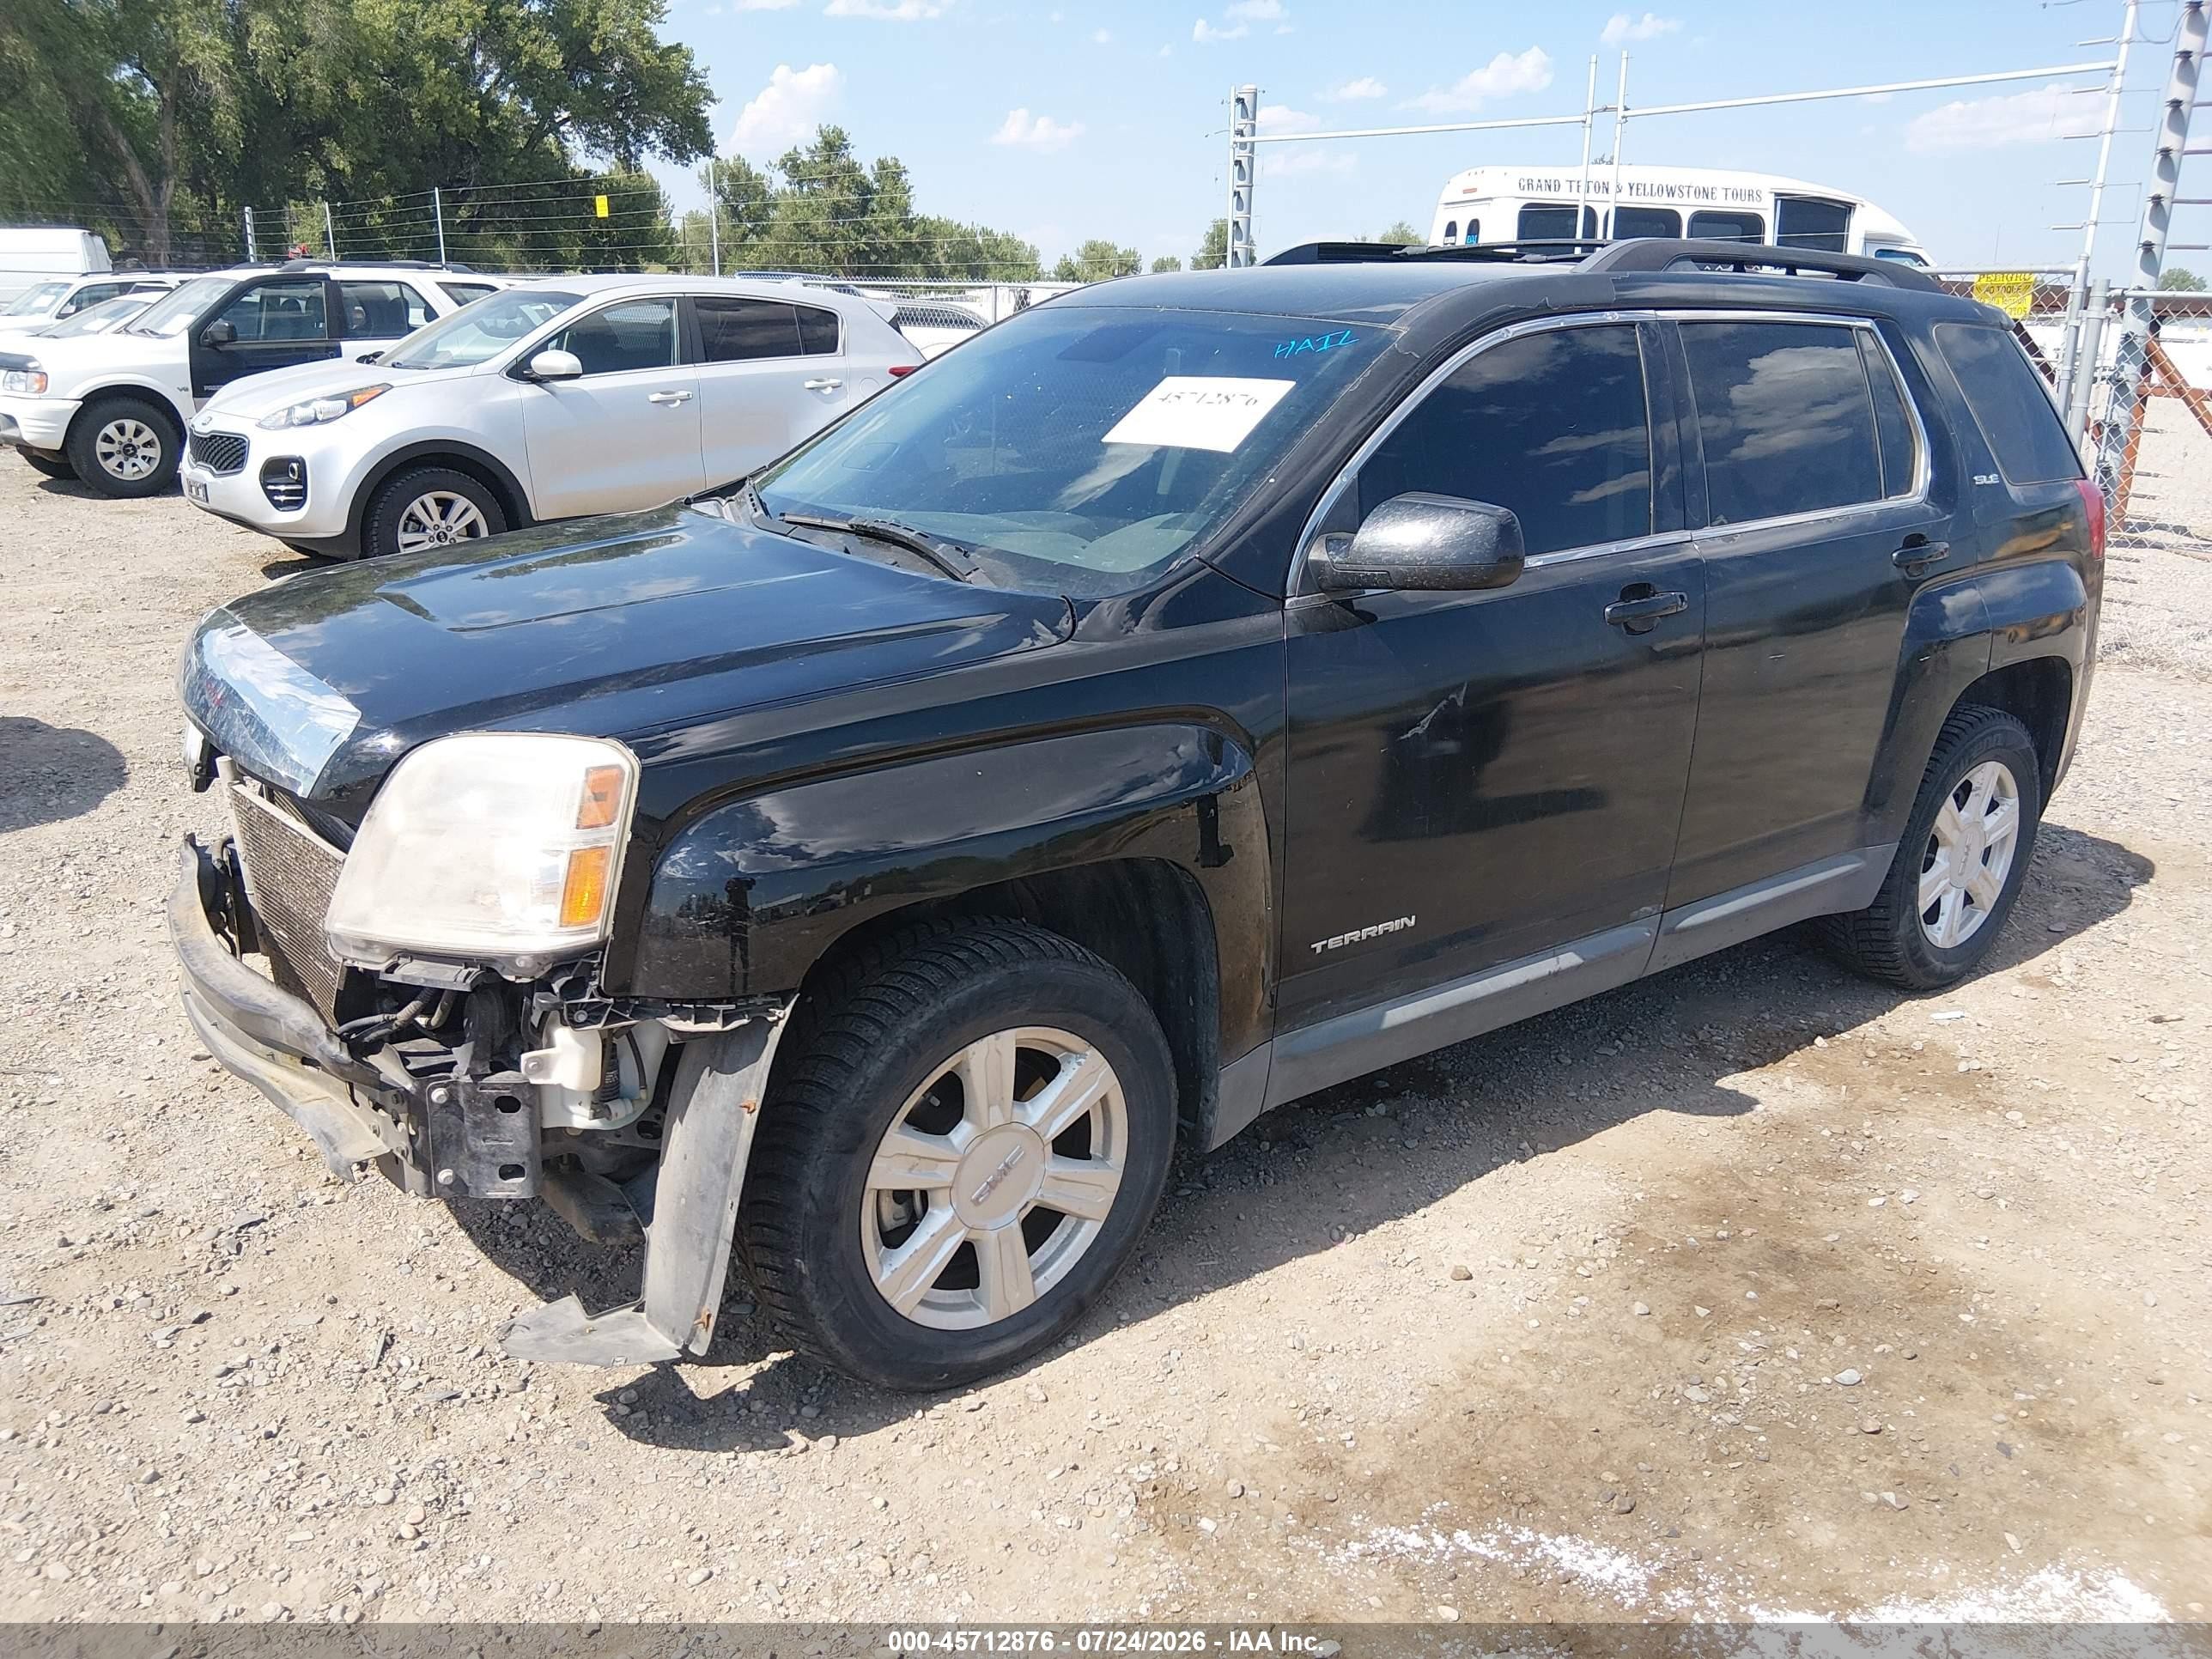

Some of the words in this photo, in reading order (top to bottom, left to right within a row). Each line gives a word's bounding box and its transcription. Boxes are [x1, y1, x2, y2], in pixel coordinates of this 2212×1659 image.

[1518, 177, 1561, 193] GRAND
[1628, 181, 1718, 201] YELLOWSTONE
[1721, 186, 1763, 203] TOURS
[1273, 329, 1360, 359] HAIL
[1310, 915, 1416, 954] TERRAIN
[970, 1145, 1025, 1206] GMC
